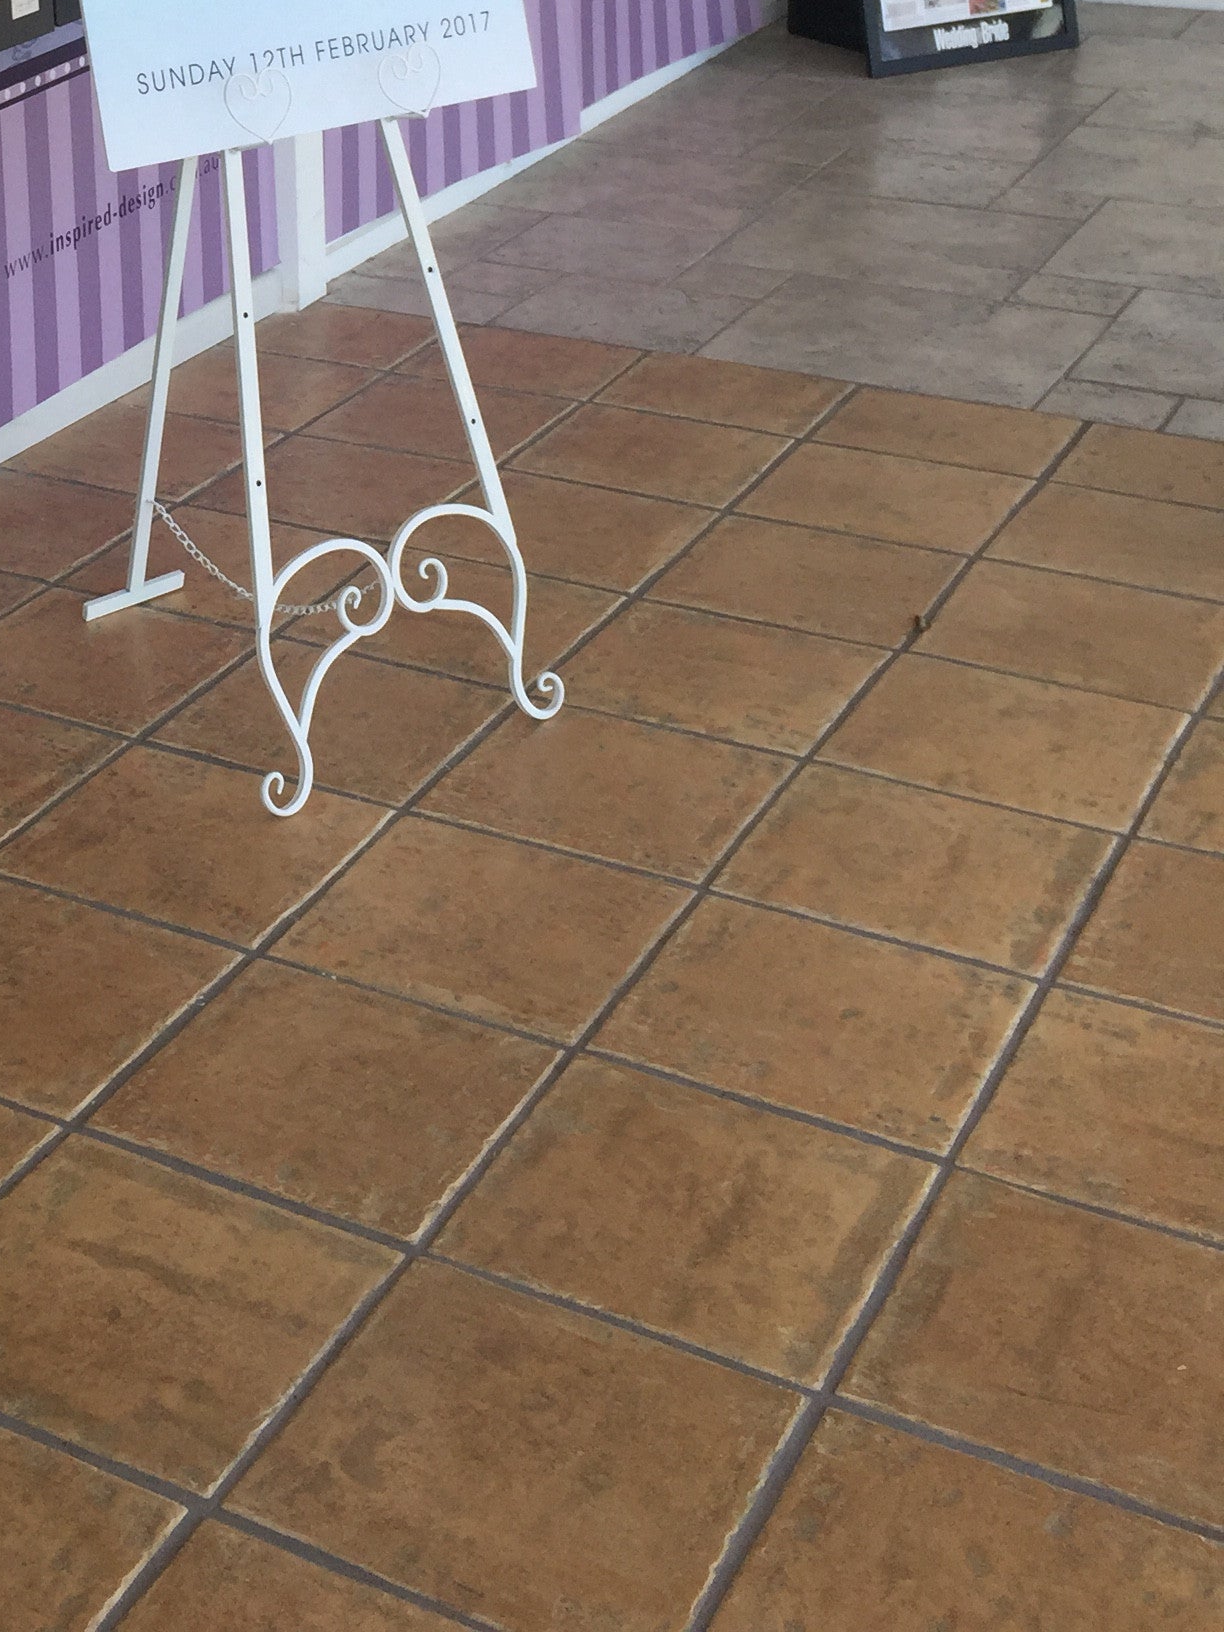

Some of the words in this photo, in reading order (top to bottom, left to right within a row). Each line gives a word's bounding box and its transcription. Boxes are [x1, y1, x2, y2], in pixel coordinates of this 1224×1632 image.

[137, 55, 237, 96] SUNDAY
[315, 20, 429, 63] FEBRUARY
[440, 10, 491, 40] 2017
[4, 155, 220, 280] www.inspired-design.c.au
